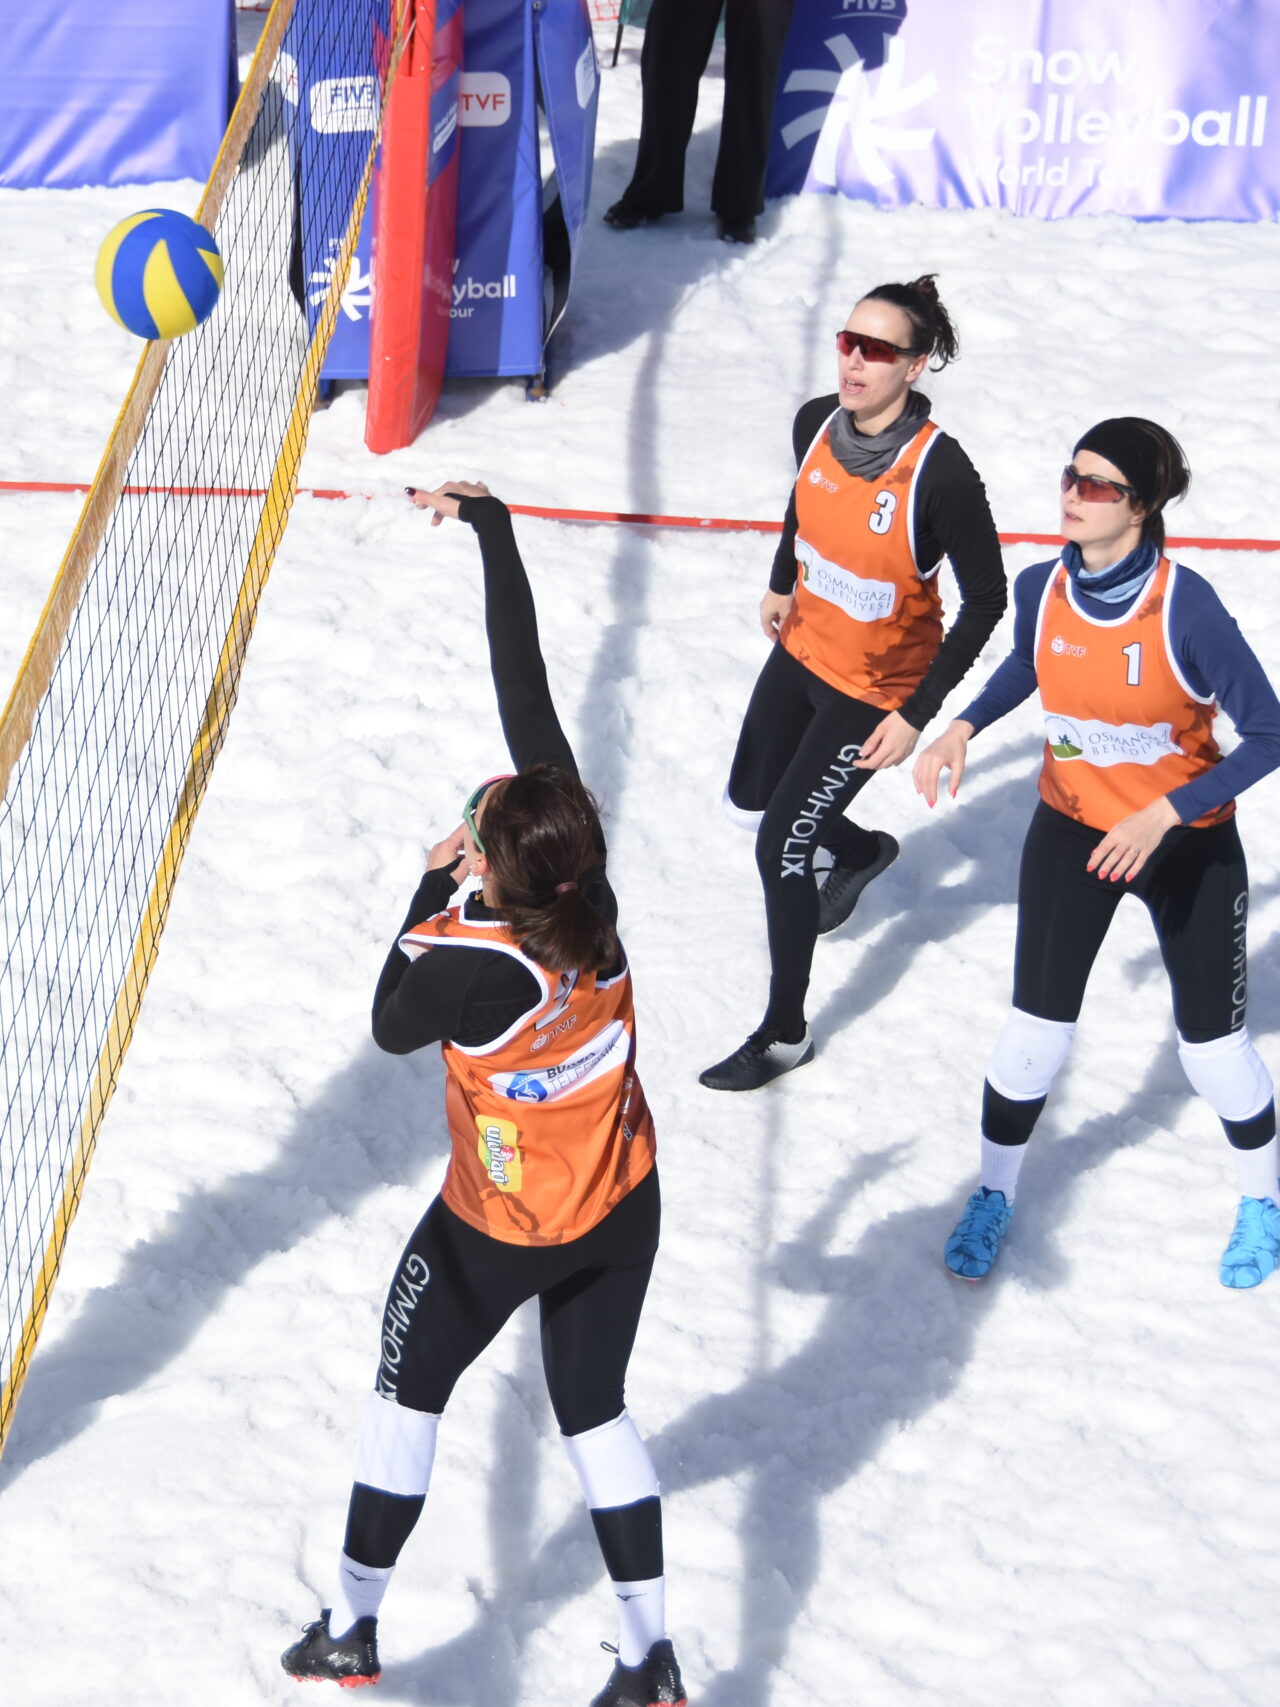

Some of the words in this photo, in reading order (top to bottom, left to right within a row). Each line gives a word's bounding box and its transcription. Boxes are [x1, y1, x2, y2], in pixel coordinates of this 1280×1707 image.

[968, 33, 1139, 85] Snow
[461, 93, 506, 112] TVF
[964, 94, 1268, 160] Volleyball
[962, 156, 1070, 188] World
[1081, 157, 1161, 188] Tour
[448, 307, 475, 318] our
[451, 275, 516, 306] yball
[868, 489, 898, 536] 3
[1122, 642, 1142, 687] 1
[780, 744, 866, 879] GYMHOLIX
[1230, 891, 1249, 1030] GYMHOLI
